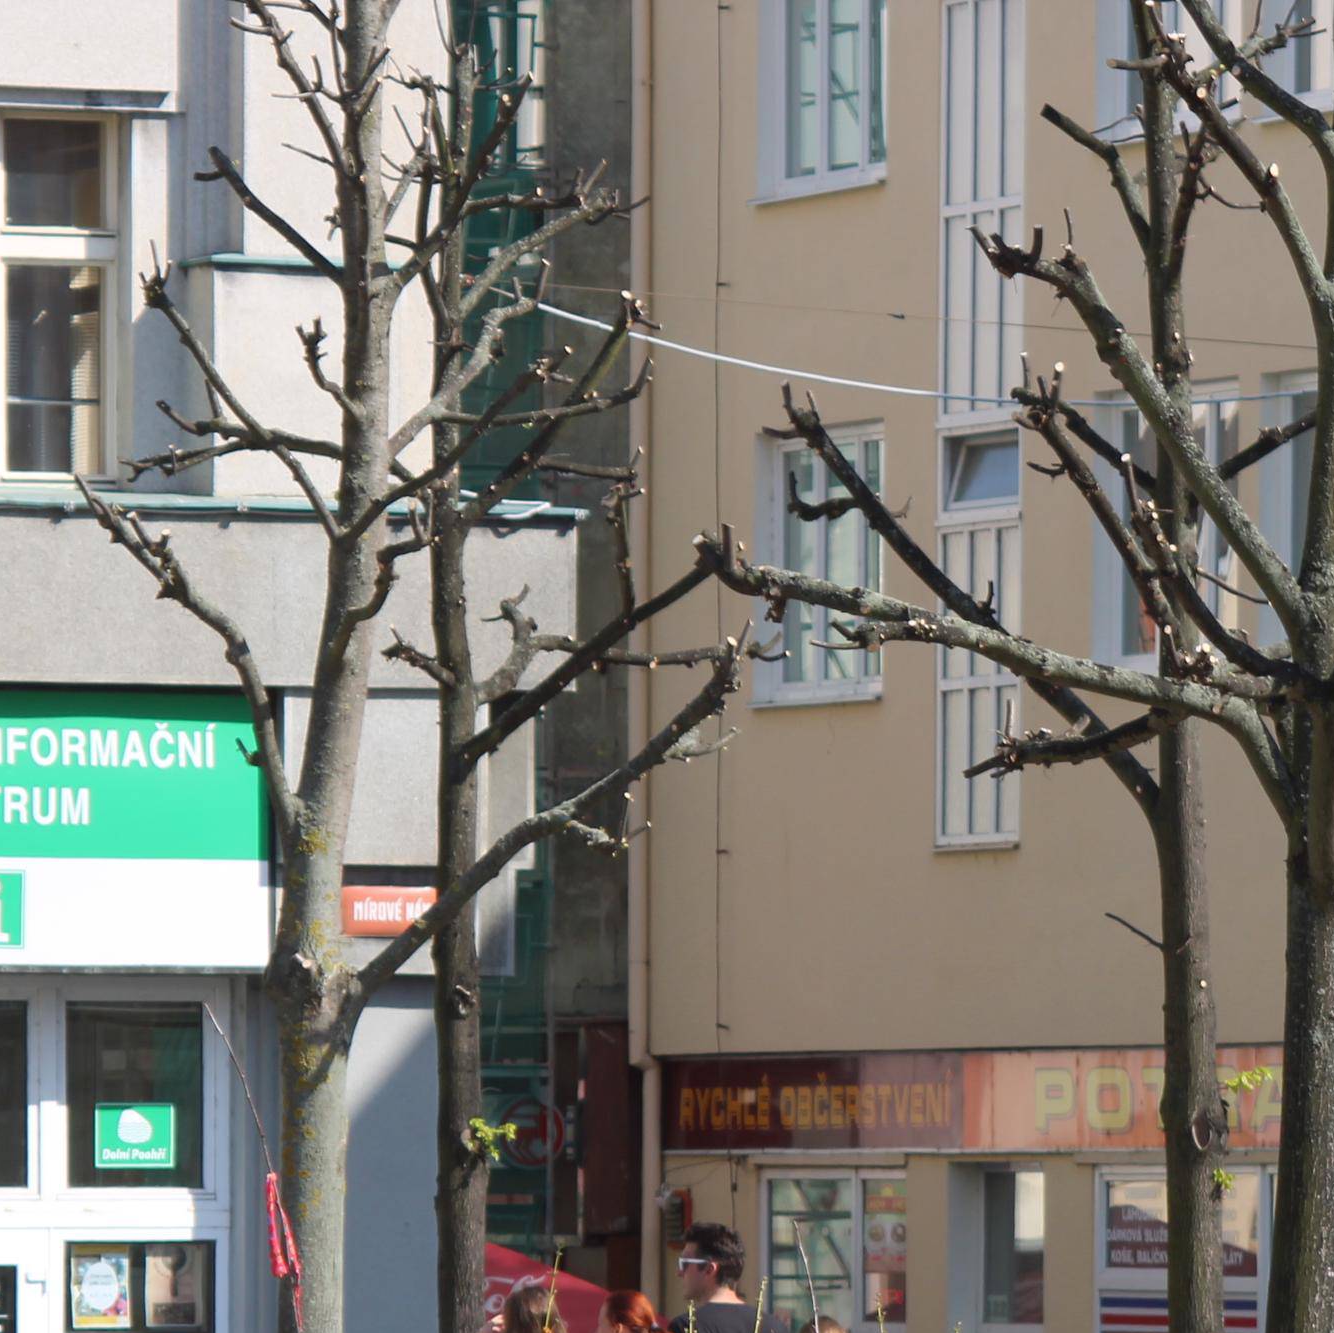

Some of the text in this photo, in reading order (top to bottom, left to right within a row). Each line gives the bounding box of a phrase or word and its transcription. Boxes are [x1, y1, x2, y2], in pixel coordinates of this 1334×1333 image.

[353, 896, 402, 922] MÍROVÉ
[679, 1067, 954, 1131] RYCHLÉ OBČERSTVENÍ
